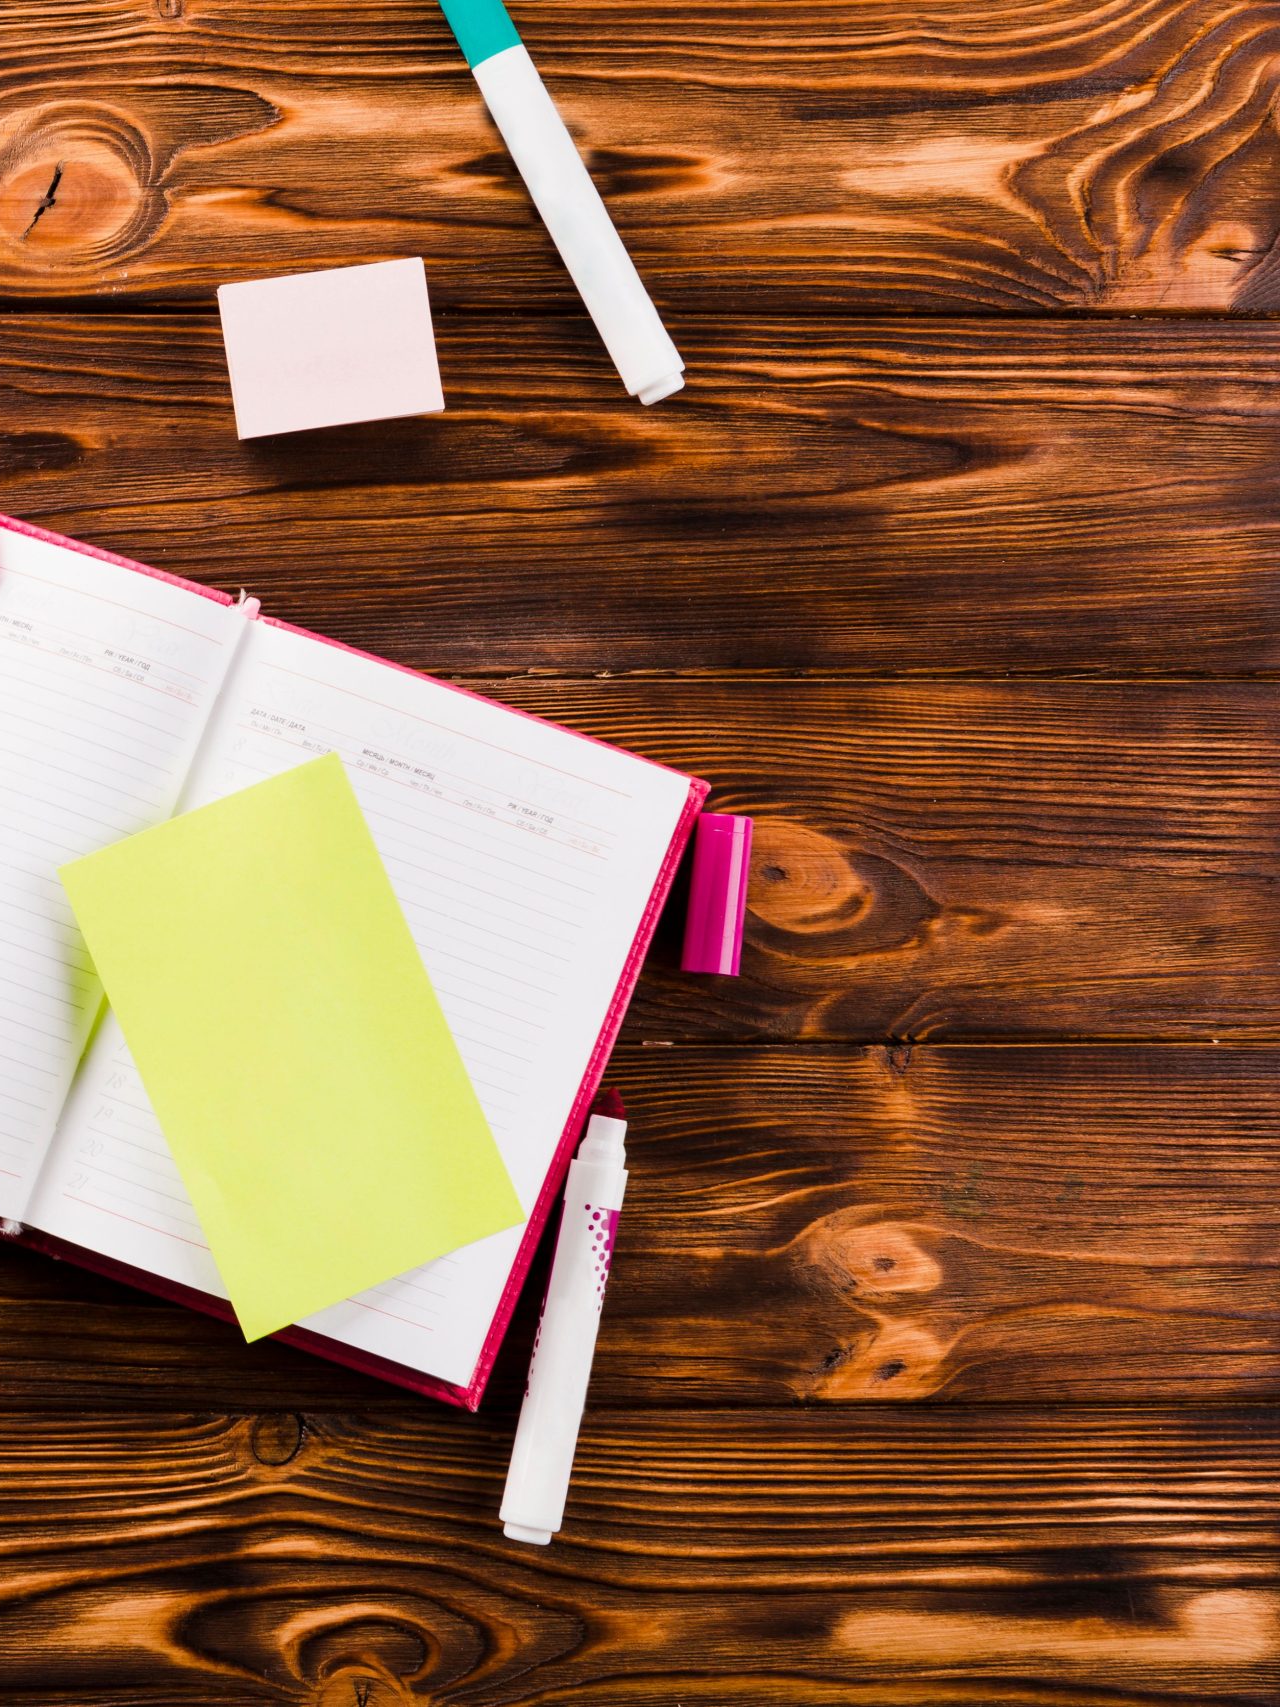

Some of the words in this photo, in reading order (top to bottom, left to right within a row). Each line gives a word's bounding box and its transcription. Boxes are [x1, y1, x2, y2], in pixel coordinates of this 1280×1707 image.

[118, 654, 134, 664] YEAR
[389, 758, 411, 770] MONTH
[522, 807, 538, 817] YEAR
